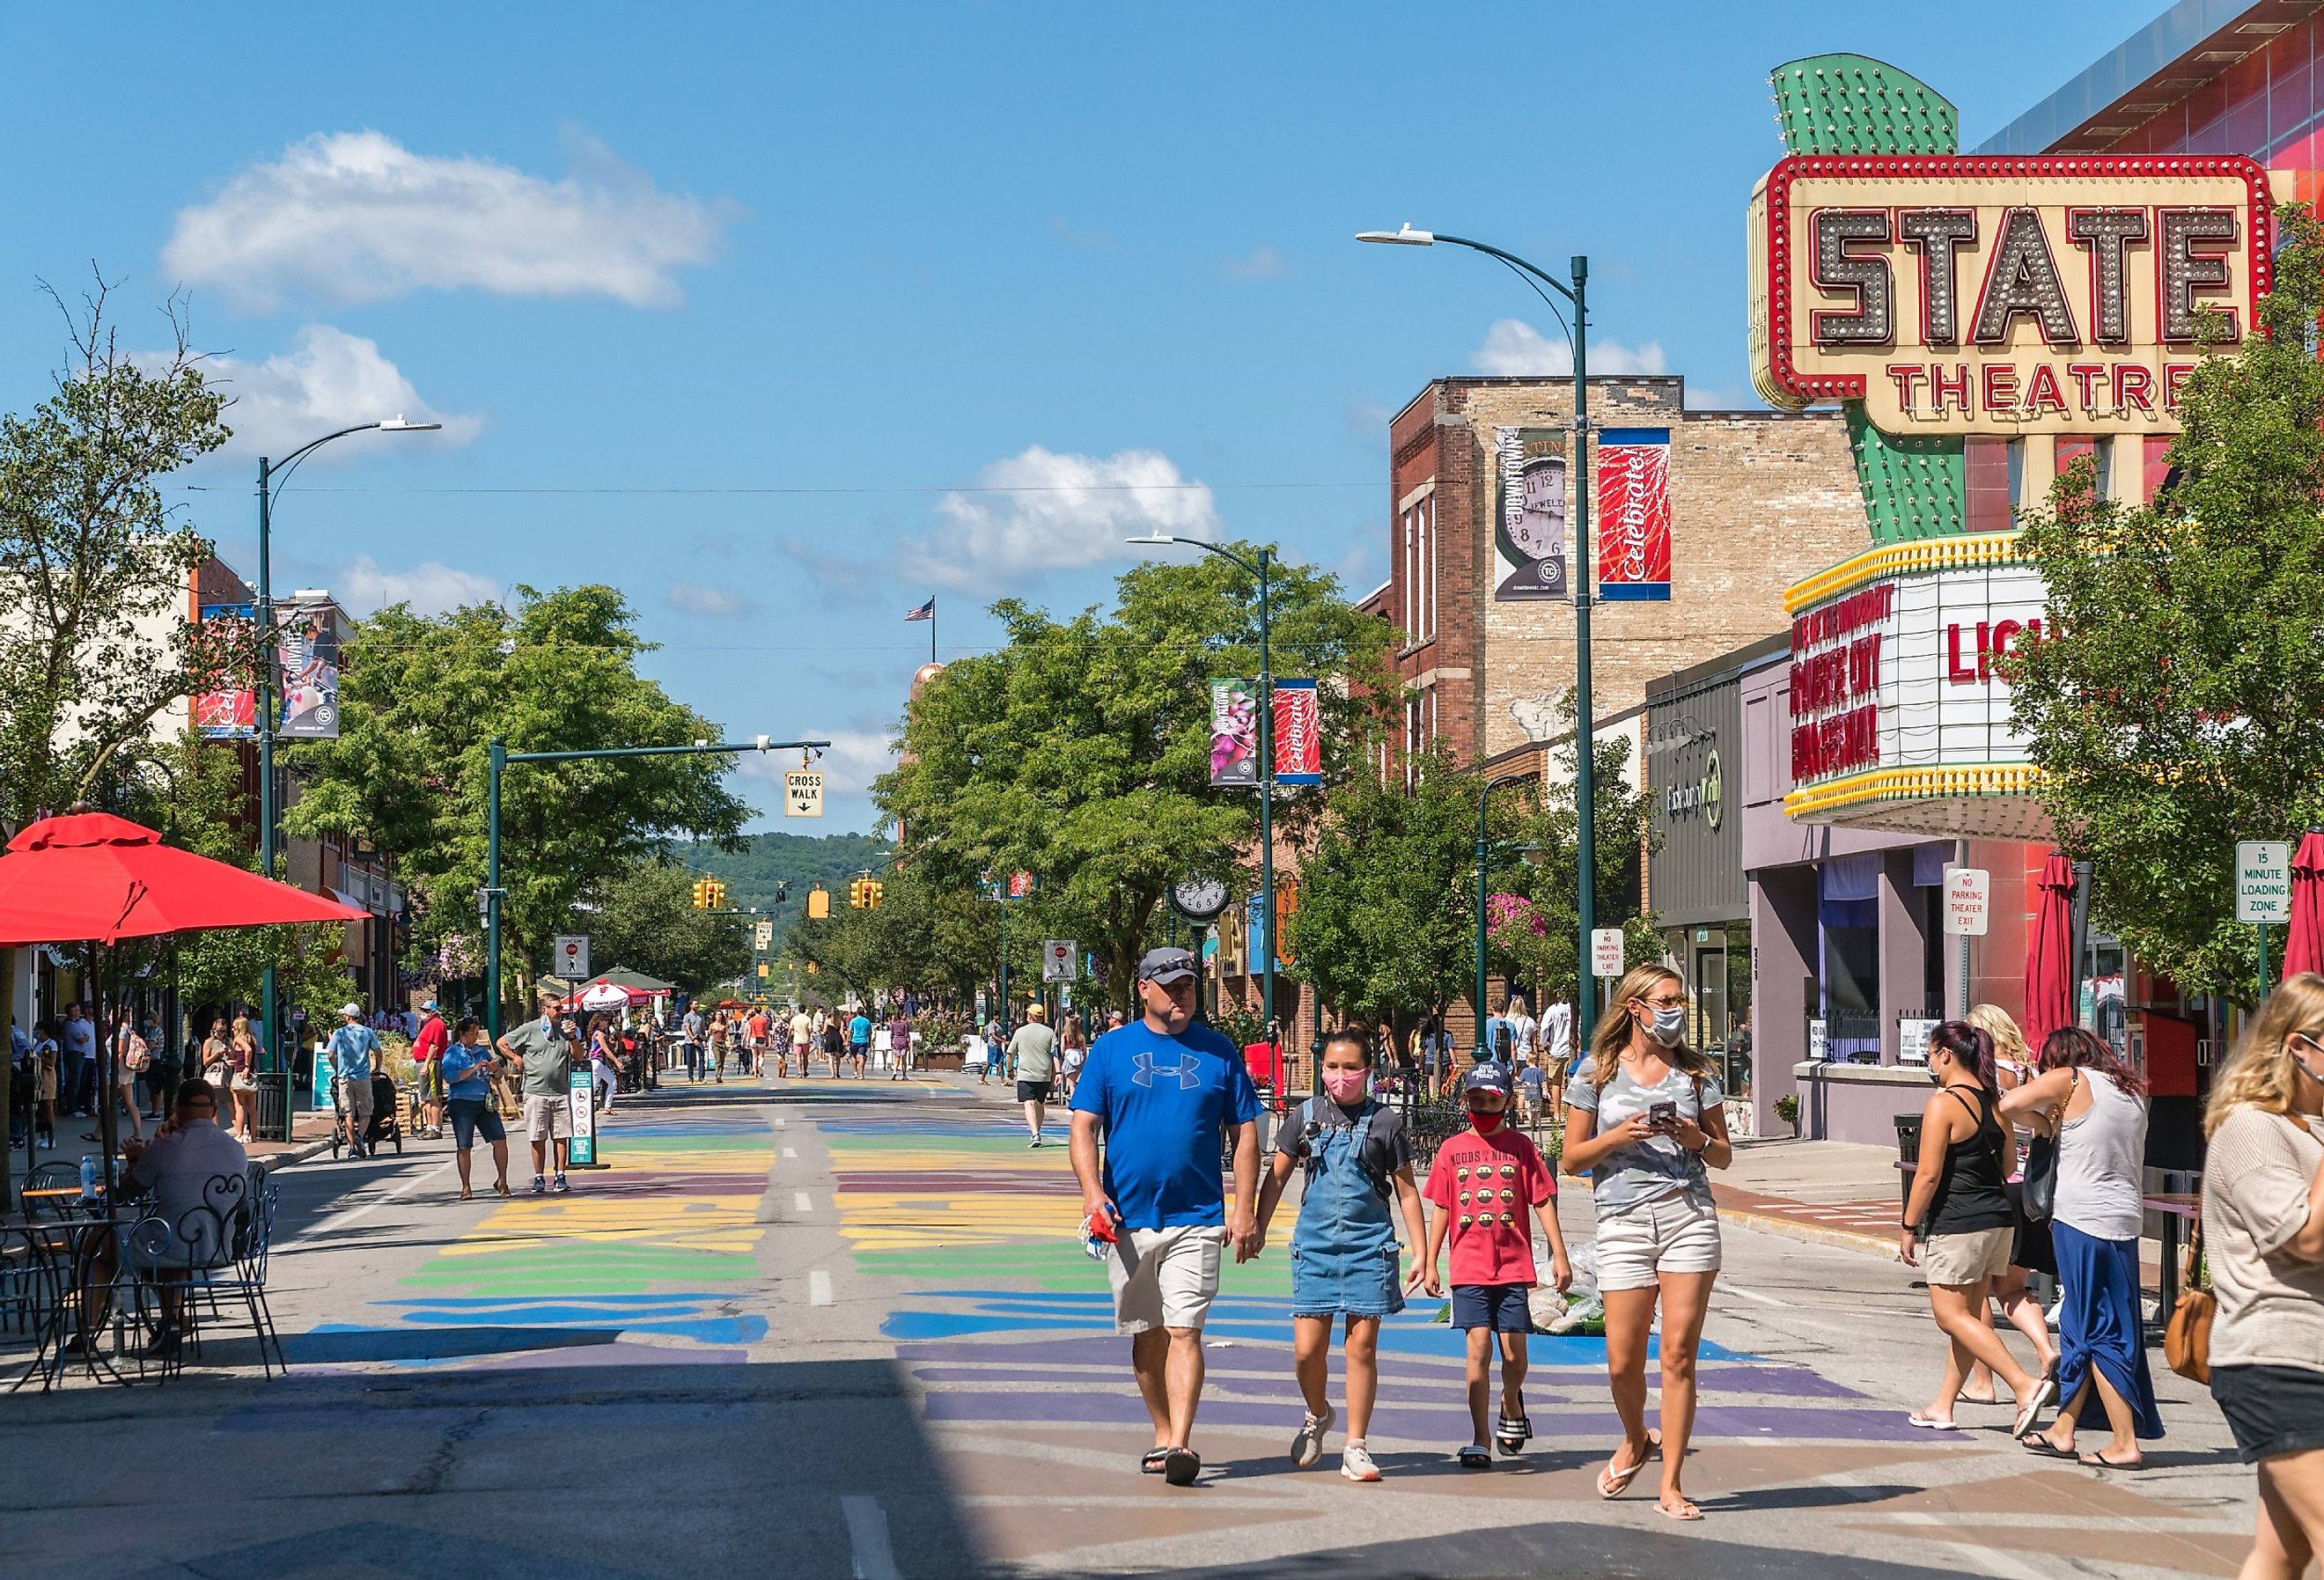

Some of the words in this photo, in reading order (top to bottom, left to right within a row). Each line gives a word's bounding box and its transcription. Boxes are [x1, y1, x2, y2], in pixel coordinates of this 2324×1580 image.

[1809, 206, 2241, 345] STATE
[1886, 363, 2196, 412] THEATRE
[1505, 439, 1524, 515] DOWNTOWN
[1541, 475, 1554, 488] 12
[1526, 481, 1537, 495] 11
[1530, 499, 1565, 513] JEWELE
[1624, 448, 1646, 580] Celebrate!
[1521, 529, 1530, 542] 8
[1535, 540, 1543, 550] 7
[1551, 541, 1561, 555] 6
[1291, 690, 1303, 773] Celebrate!
[789, 775, 821, 786] CROSS
[791, 789, 818, 799] WALK
[2258, 853, 2269, 863] 15
[2245, 870, 2282, 879] MINUTE
[1952, 891, 1982, 900] PARKING
[2241, 885, 2285, 895] LOADING
[1951, 903, 1982, 913] THEATER
[2250, 900, 2277, 911] ZONE
[1450, 1151, 1481, 1166] MOODS
